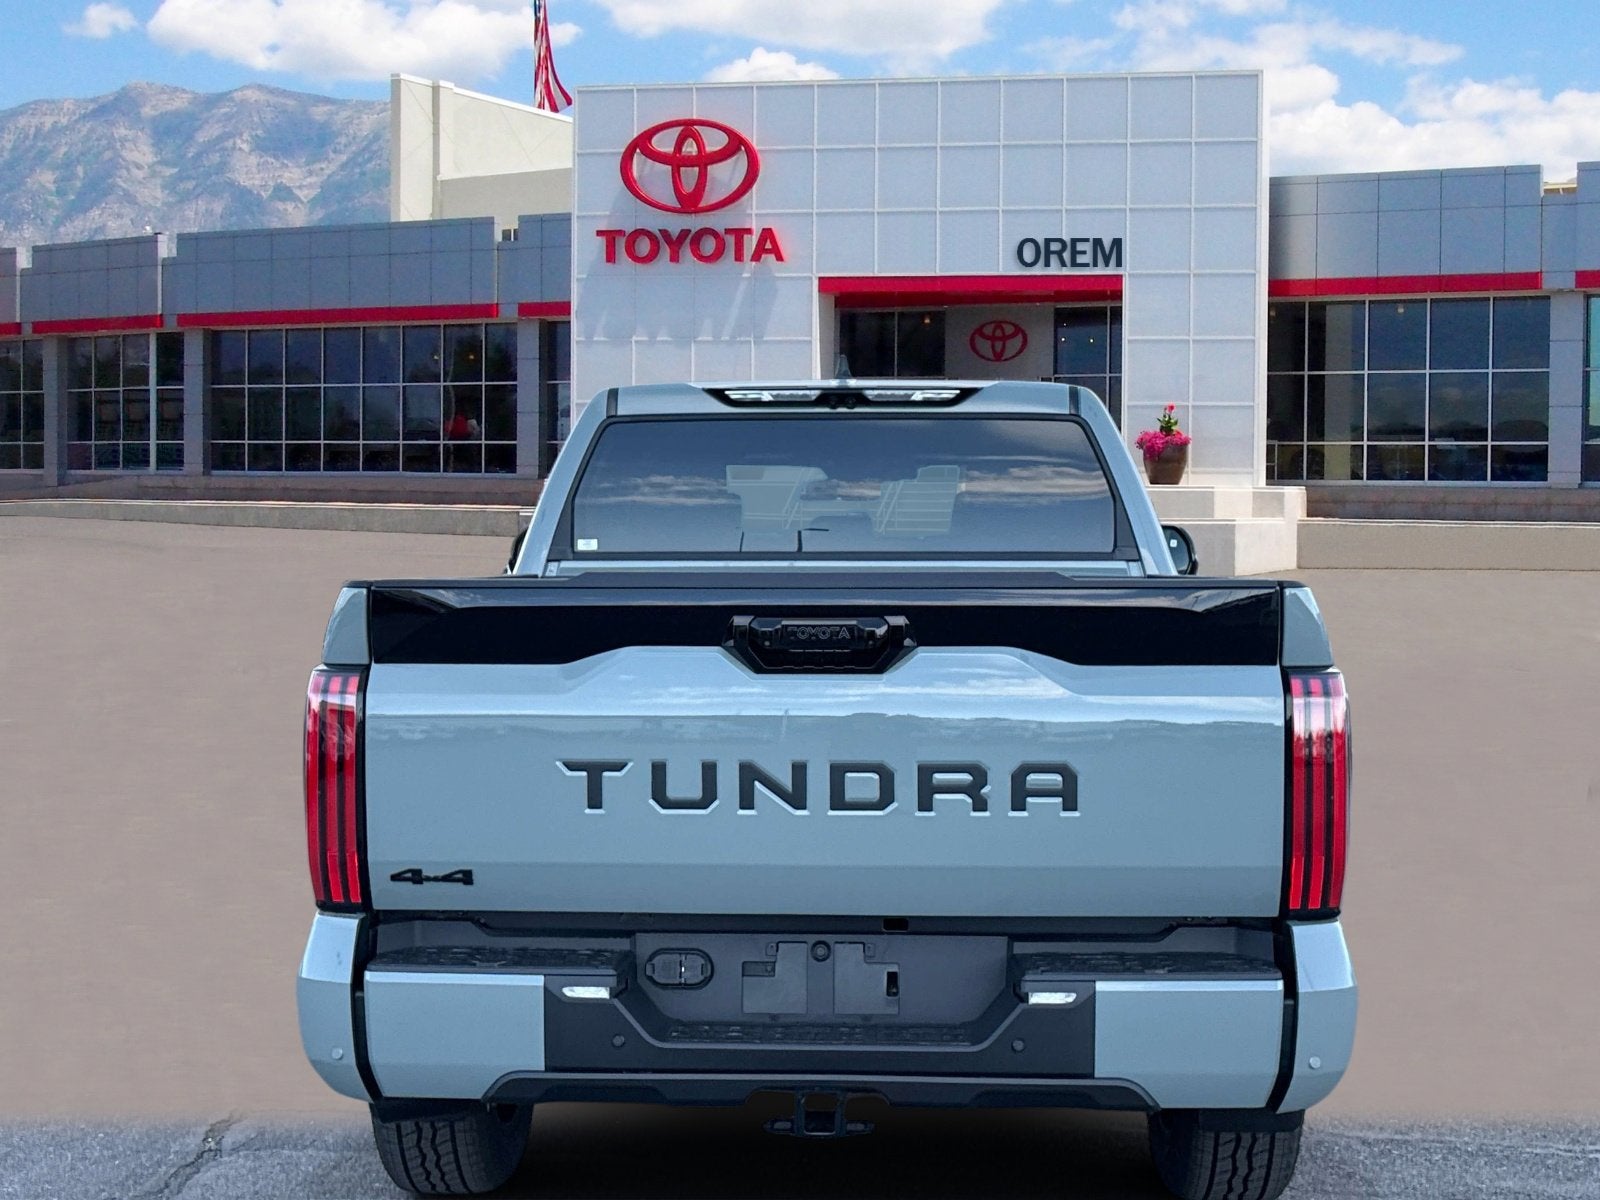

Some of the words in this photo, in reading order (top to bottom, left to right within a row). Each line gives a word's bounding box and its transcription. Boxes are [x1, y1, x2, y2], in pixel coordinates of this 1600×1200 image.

[596, 227, 785, 264] TOYOTA
[1016, 237, 1123, 269] OREM
[787, 625, 851, 640] TOYOTA
[556, 759, 1080, 817] TUNDRA
